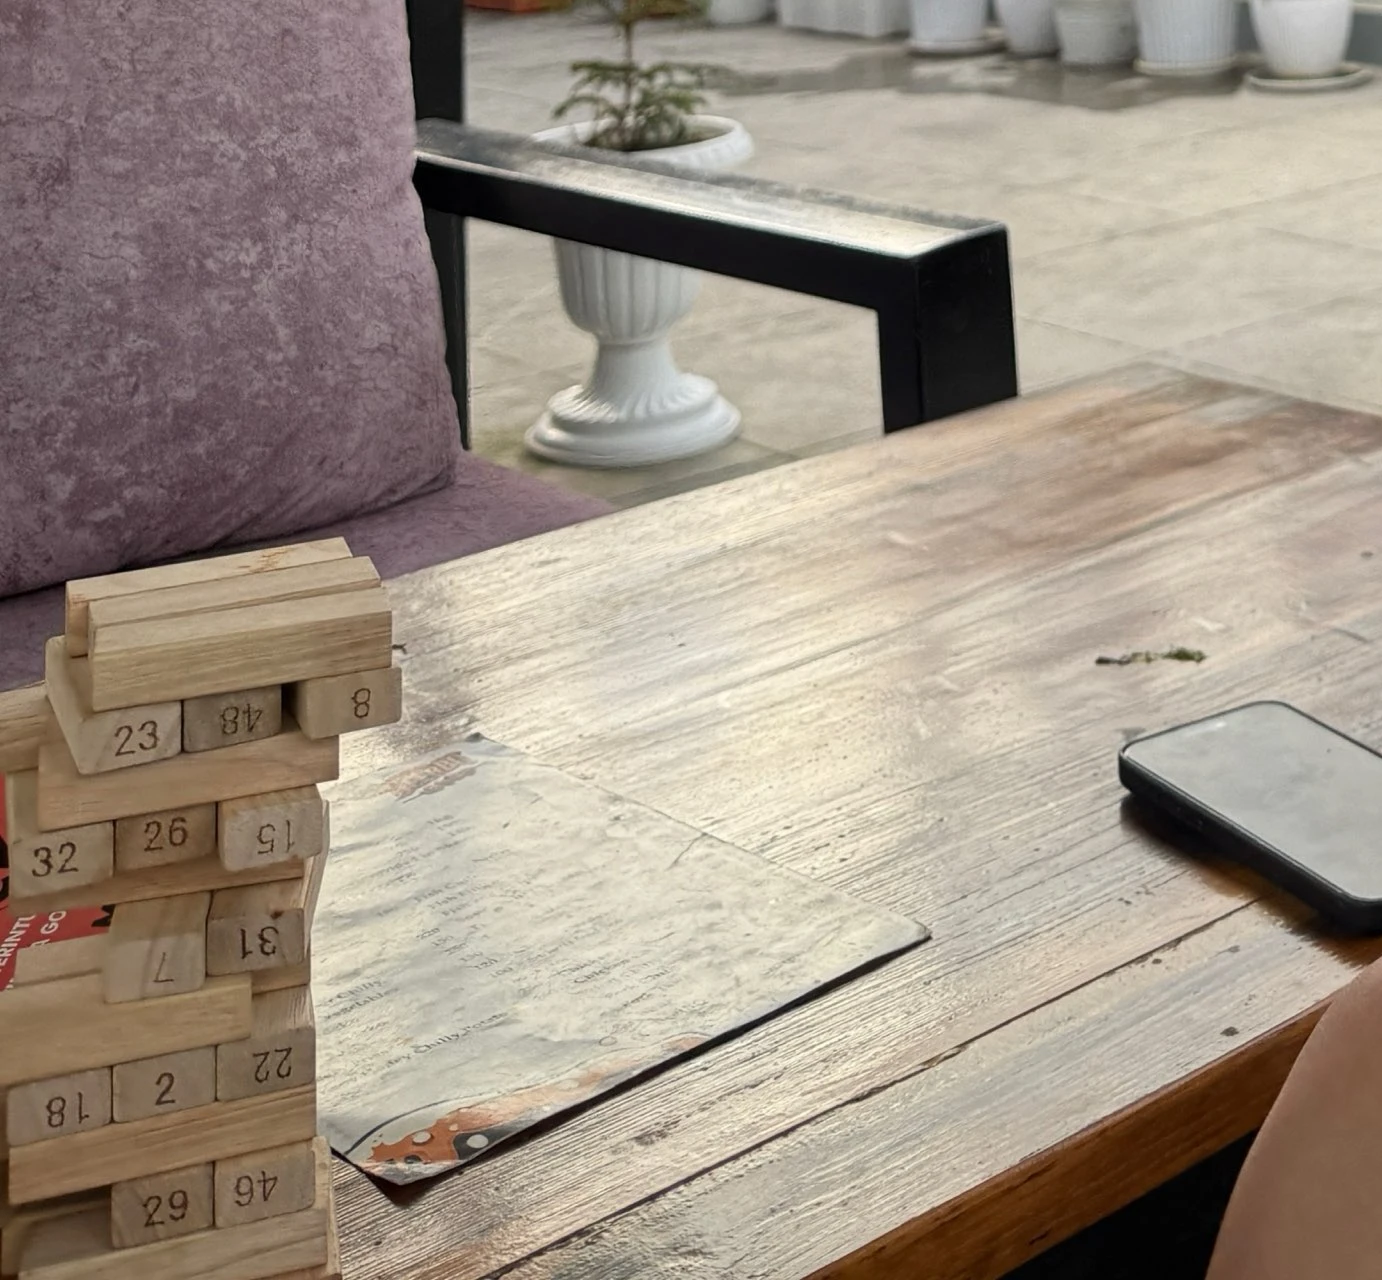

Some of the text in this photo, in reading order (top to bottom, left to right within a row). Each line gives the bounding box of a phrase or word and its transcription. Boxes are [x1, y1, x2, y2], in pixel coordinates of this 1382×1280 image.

[221, 703, 265, 736] 48
[351, 687, 371, 719] 8
[114, 720, 159, 756] 23
[143, 816, 188, 852] 26
[257, 819, 295, 855] 15
[31, 841, 79, 878] 32
[0, 914, 36, 973] ERINT
[239, 926, 280, 960] 31
[152, 951, 175, 983] 7
[253, 1047, 294, 1083] 22
[155, 1072, 176, 1106] 2
[46, 1092, 91, 1129] 18
[234, 1170, 278, 1207] 46
[141, 1189, 189, 1228] 29
